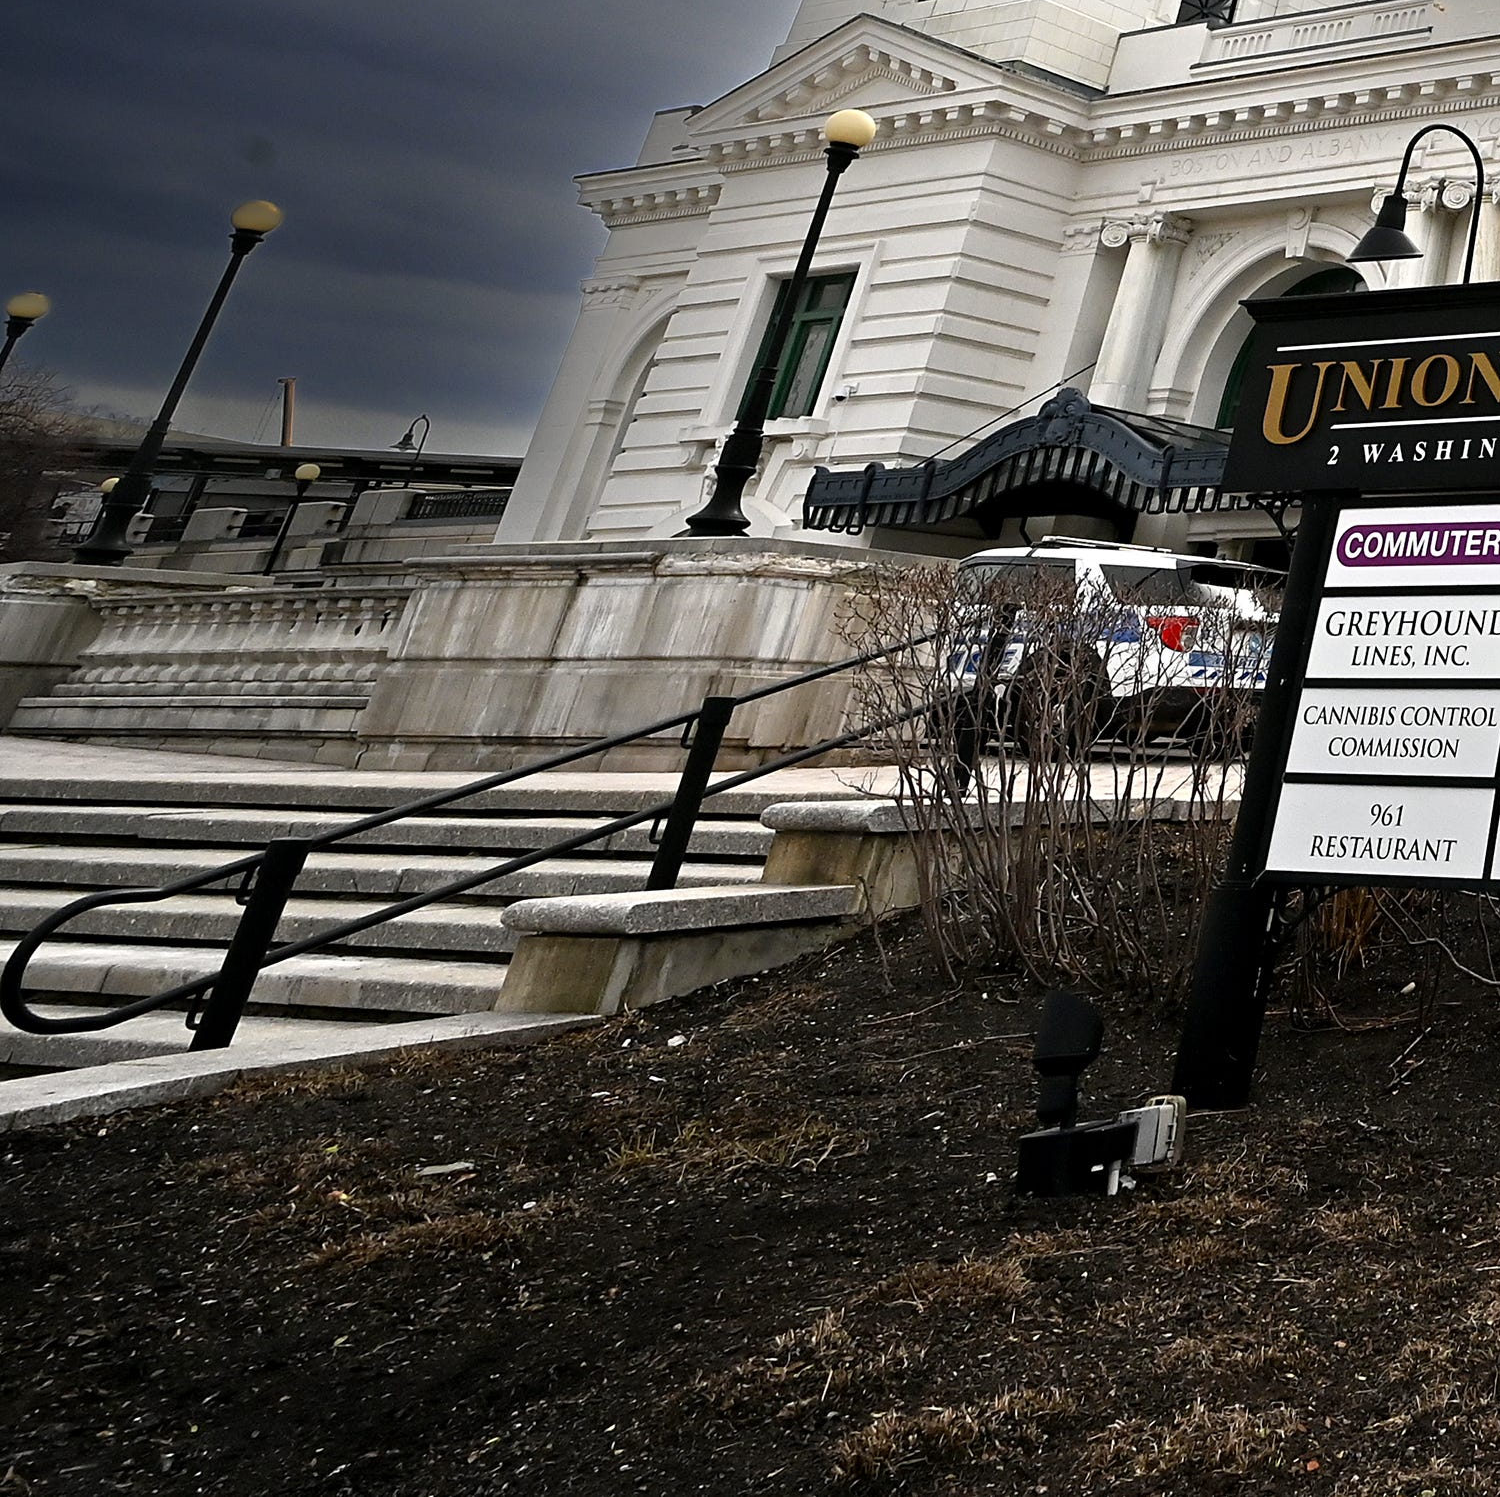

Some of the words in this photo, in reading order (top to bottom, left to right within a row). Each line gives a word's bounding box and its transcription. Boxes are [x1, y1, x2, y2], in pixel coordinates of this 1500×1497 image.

[1326, 445, 1340, 466] 2
[1351, 645, 1417, 670] LINES,
[1423, 644, 1471, 667] INC.
[1303, 705, 1397, 726] CANNIBIS
[1400, 705, 1498, 728] CONTROL
[1328, 736, 1460, 759] COMMISSION
[1370, 803, 1404, 828] 961
[1309, 835, 1458, 863] RESTAURANT
